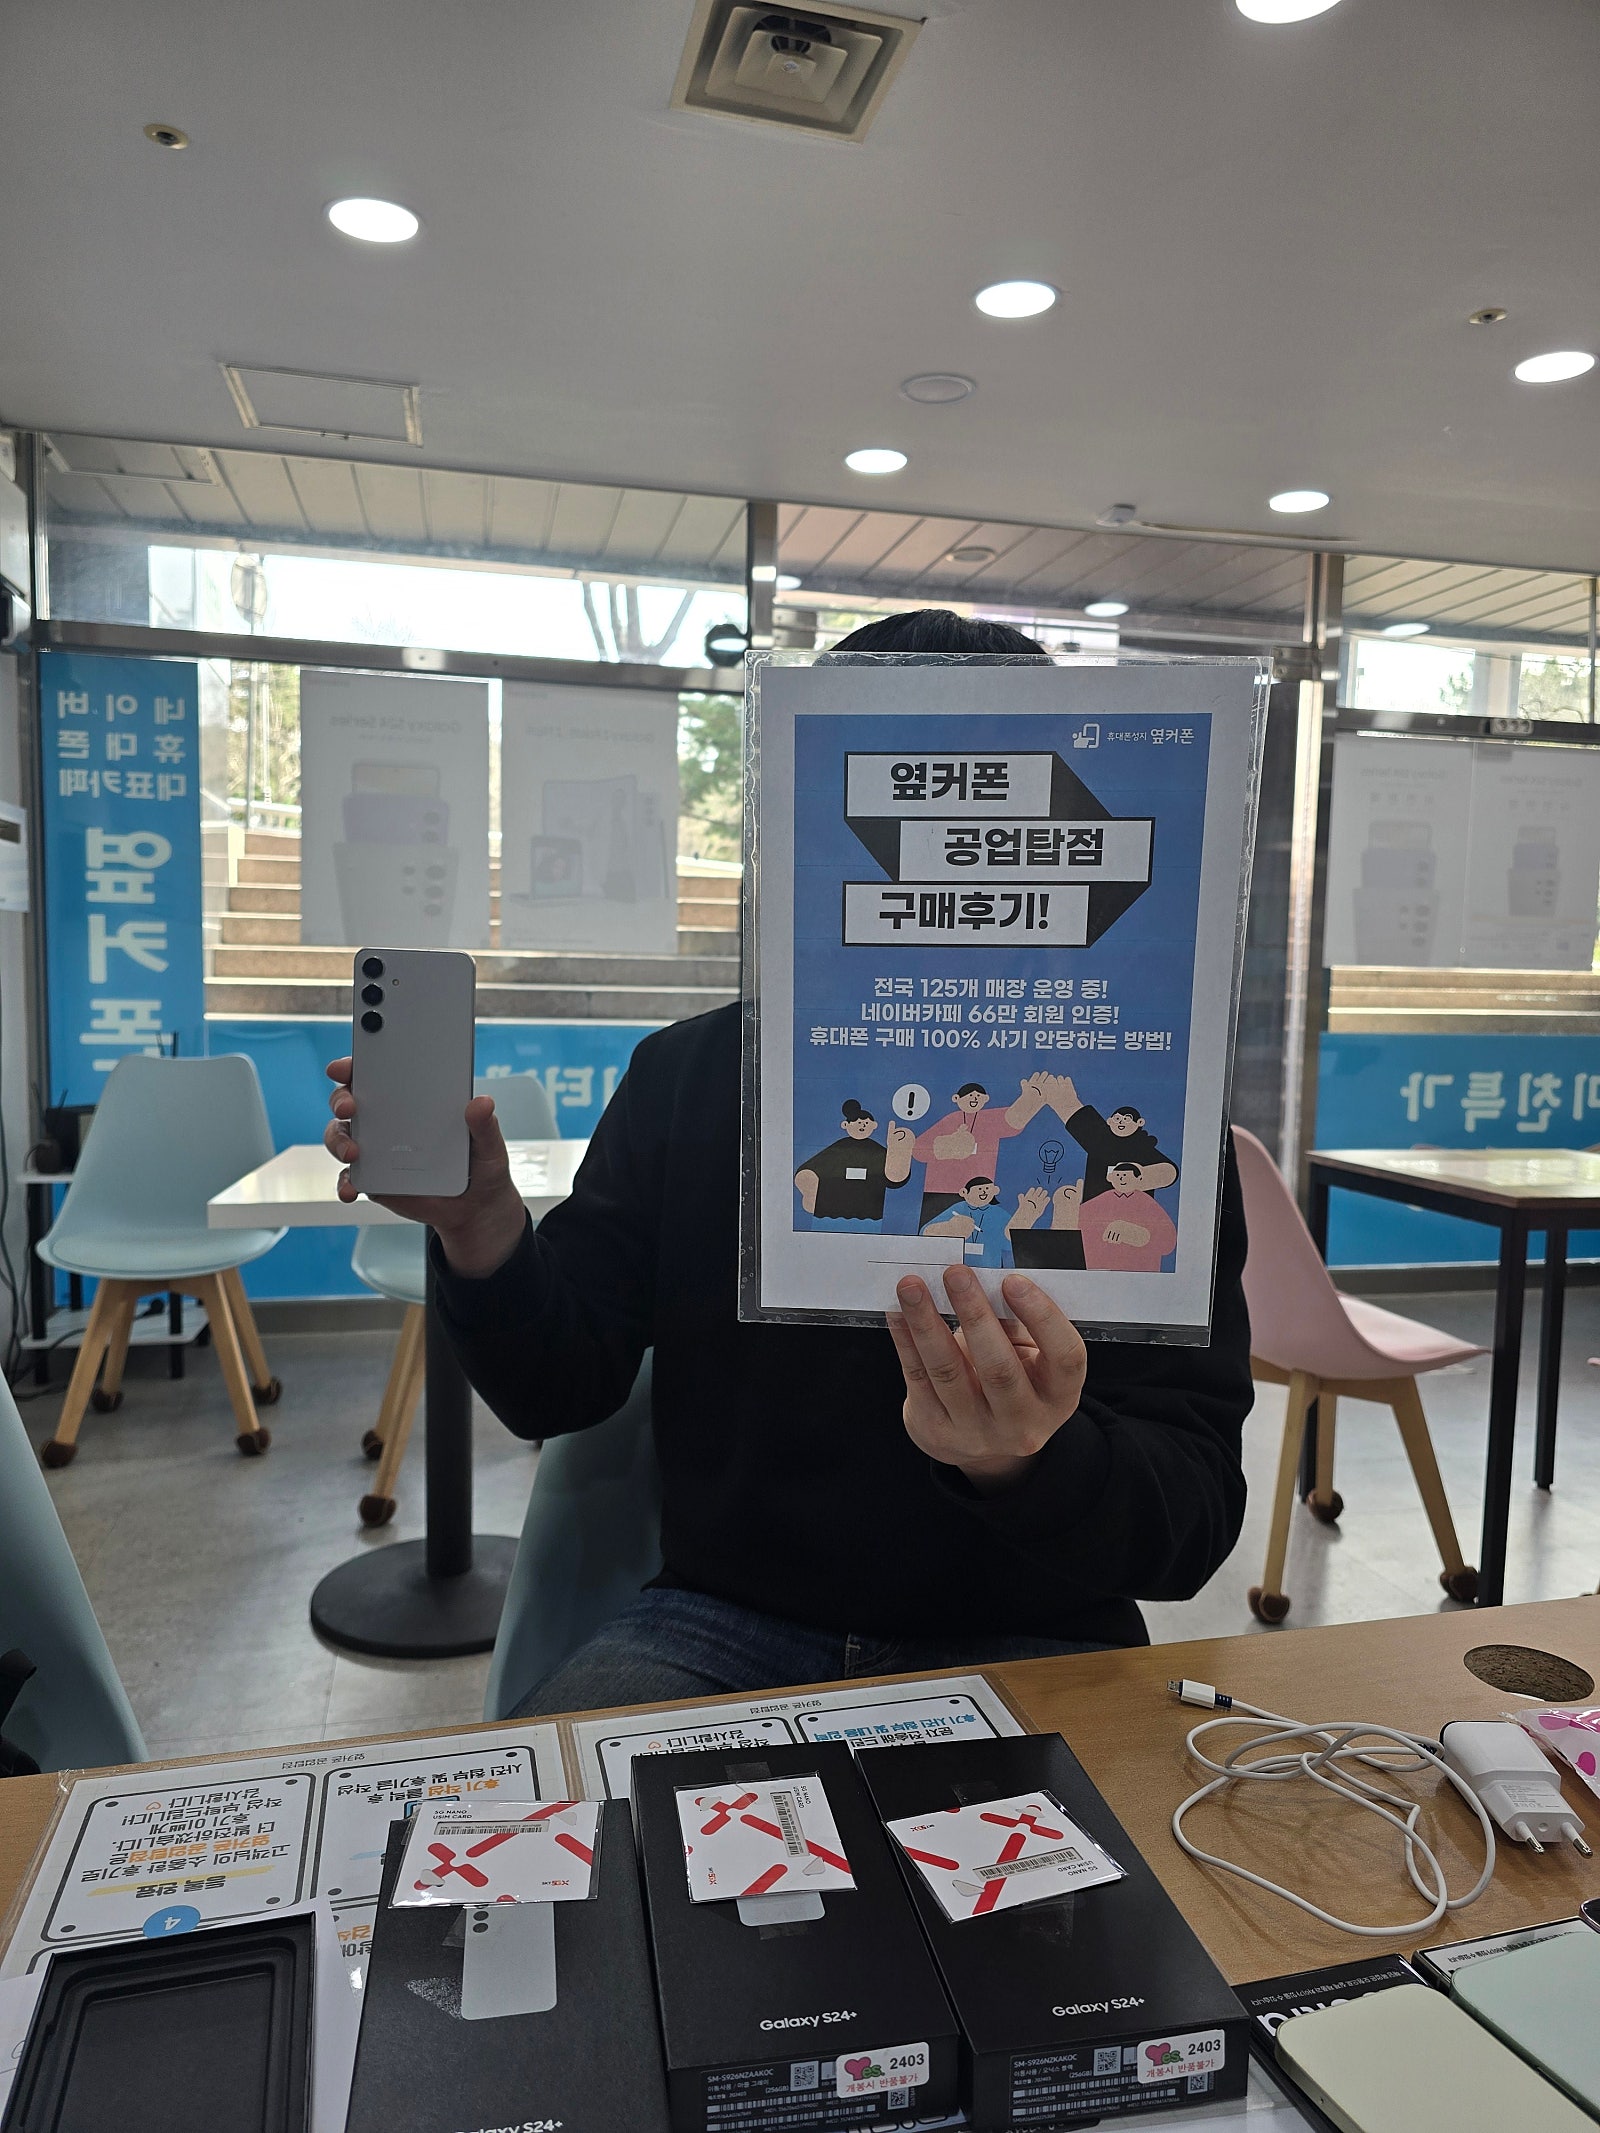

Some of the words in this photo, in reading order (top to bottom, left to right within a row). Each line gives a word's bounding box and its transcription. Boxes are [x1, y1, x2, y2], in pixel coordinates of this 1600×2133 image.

[1151, 728, 1194, 745] 옆커폰
[890, 761, 1010, 801] 옆커폰
[944, 828, 1104, 866] 공업탑점
[878, 891, 1050, 930] 구매후기!
[874, 977, 914, 998] 전국
[921, 978, 979, 998] 125개
[985, 980, 1026, 999] 매장
[1033, 979, 1074, 999] 운영
[1081, 980, 1108, 999] 중!
[861, 1004, 962, 1023] 네이버카페
[969, 1005, 1016, 1024] 66만
[1023, 1006, 1064, 1024] 회원
[1072, 1006, 1119, 1025] 인증!
[810, 1027, 868, 1046] 휴대폰
[876, 1028, 914, 1047] 구매
[921, 1030, 980, 1048] 100%
[987, 1030, 1026, 1049] 사기
[1034, 1031, 1116, 1051] 안당하는
[1125, 1032, 1171, 1051] 방법!
[749, 1705, 790, 1714] 공업탑점
[890, 1721, 918, 1732] 첨부
[921, 1717, 946, 1727] 사진
[949, 1714, 976, 1724] 후기
[843, 1726, 870, 1737] 내용
[873, 1725, 889, 1734] 및
[881, 1730, 922, 1743] 전송해
[925, 1726, 954, 1737] 문자
[667, 1730, 744, 1746] 감사합니다
[282, 1758, 328, 1770] 공업탑점
[489, 1763, 522, 1775] 사진
[431, 1772, 447, 1783] 및
[452, 1767, 486, 1780] 첨부
[336, 1783, 371, 1796] 작성
[377, 1775, 427, 1791] 후기글
[427, 1783, 461, 1797] 작성
[466, 1778, 500, 1792] 후기
[168, 1788, 261, 1807] 감사합니다
[246, 1798, 282, 1811] 작성
[366, 1793, 384, 1804] 후
[803, 1792, 811, 1805] NANO
[122, 1803, 241, 1824] 부탁드립니다!
[213, 1812, 250, 1826] 후기
[150, 1817, 206, 1834] 이쁘게
[258, 1821, 275, 1834] 더
[112, 1824, 251, 1851] 발전하겠습니다.
[213, 1835, 271, 1850] 옆커폰
[109, 1843, 207, 1865] 공업탑점은
[213, 1844, 291, 1864] 고객님의
[147, 1853, 207, 1873] 소중한
[1057, 1864, 1076, 1873] CARD
[1077, 1860, 1094, 1868] USIM
[80, 1863, 142, 1882] 후기로
[1067, 1868, 1087, 1877] NANO
[135, 1882, 178, 1898] 완료
[185, 1875, 226, 1891] 등록
[164, 1916, 181, 1930] 4
[1051, 2000, 1110, 2019] Galaxy
[1110, 1996, 1145, 2012] S24+
[760, 2013, 820, 2033] Galaxy
[822, 2008, 858, 2025] S24+
[1188, 2040, 1221, 2055] 2403
[889, 2054, 925, 2069] 2403
[1146, 2067, 1174, 2079] 개봉시
[1177, 2059, 1215, 2073] 반품불가
[846, 2081, 875, 2094] 개봉시
[879, 2074, 919, 2089] 반품불가
[523, 2119, 564, 2133] S24+
